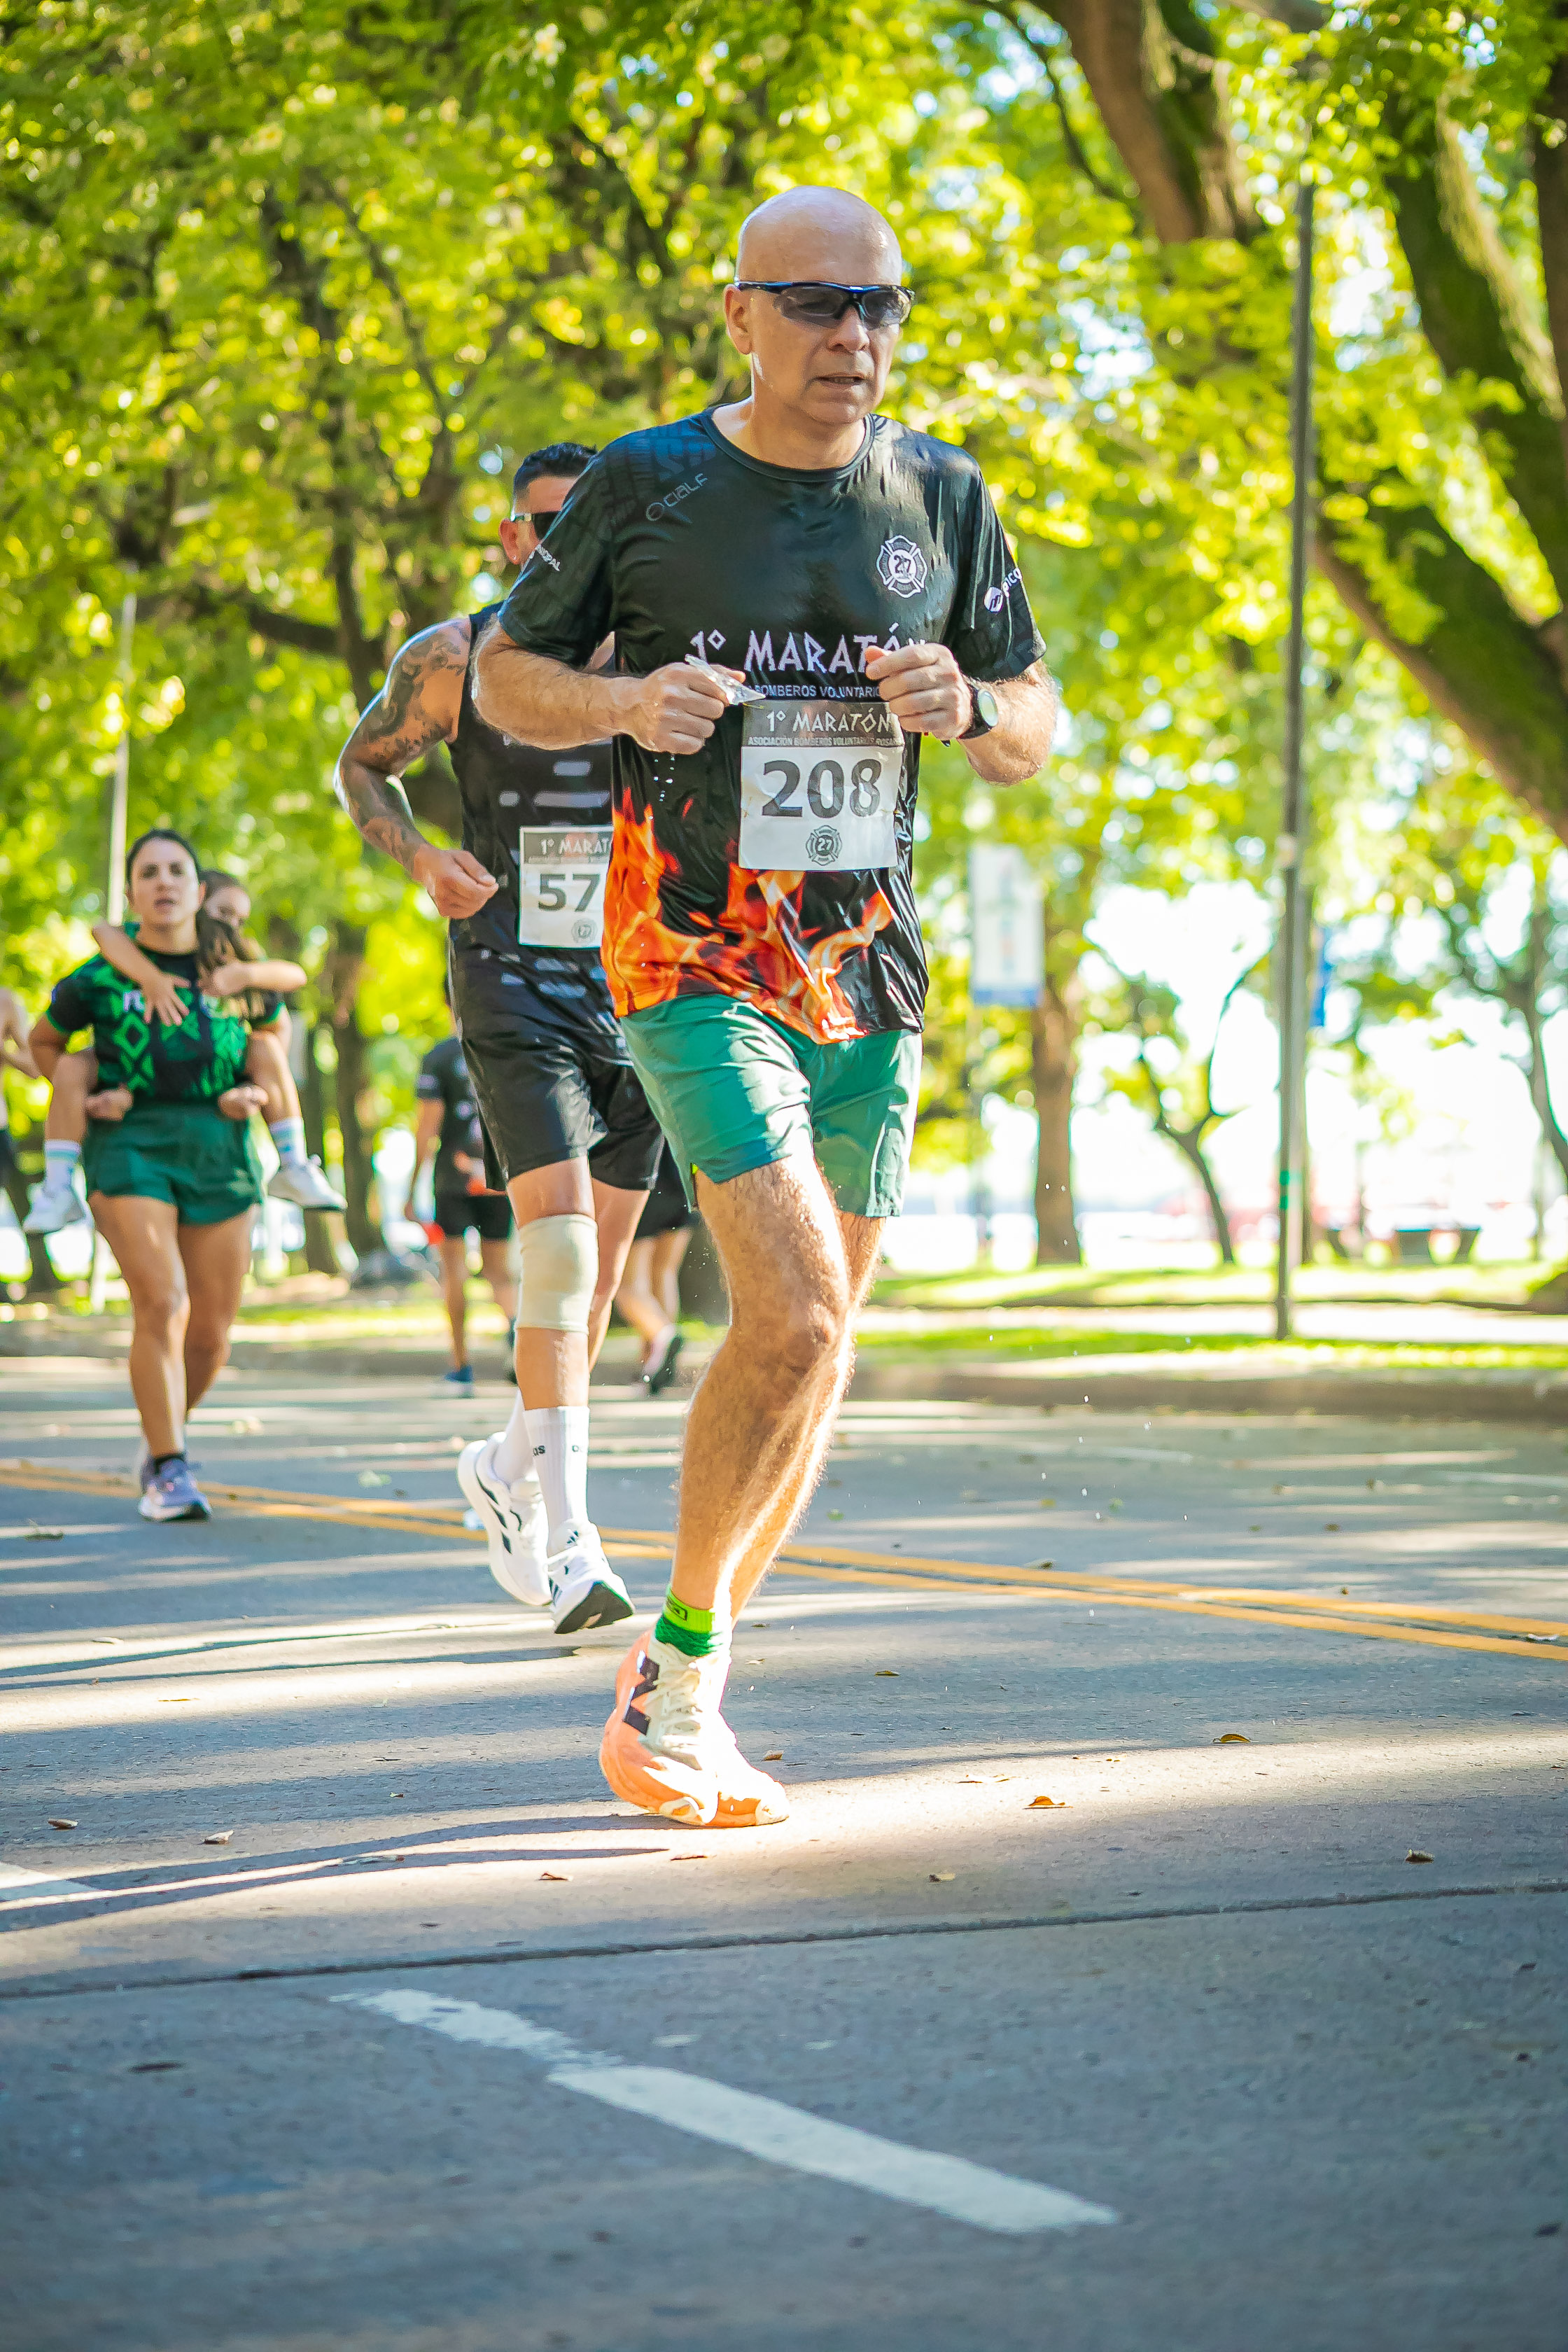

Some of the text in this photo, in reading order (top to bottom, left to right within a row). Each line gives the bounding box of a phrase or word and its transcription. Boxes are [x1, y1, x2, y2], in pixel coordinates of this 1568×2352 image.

[894, 554, 911, 574] 27
[744, 622, 926, 674] MARATÓ
[755, 685, 817, 697] BOMBEROS
[792, 707, 891, 734] MARATÓN
[762, 759, 882, 819] 208
[559, 837, 611, 855] MARAT
[817, 837, 832, 852] 27
[538, 873, 601, 913] 57
